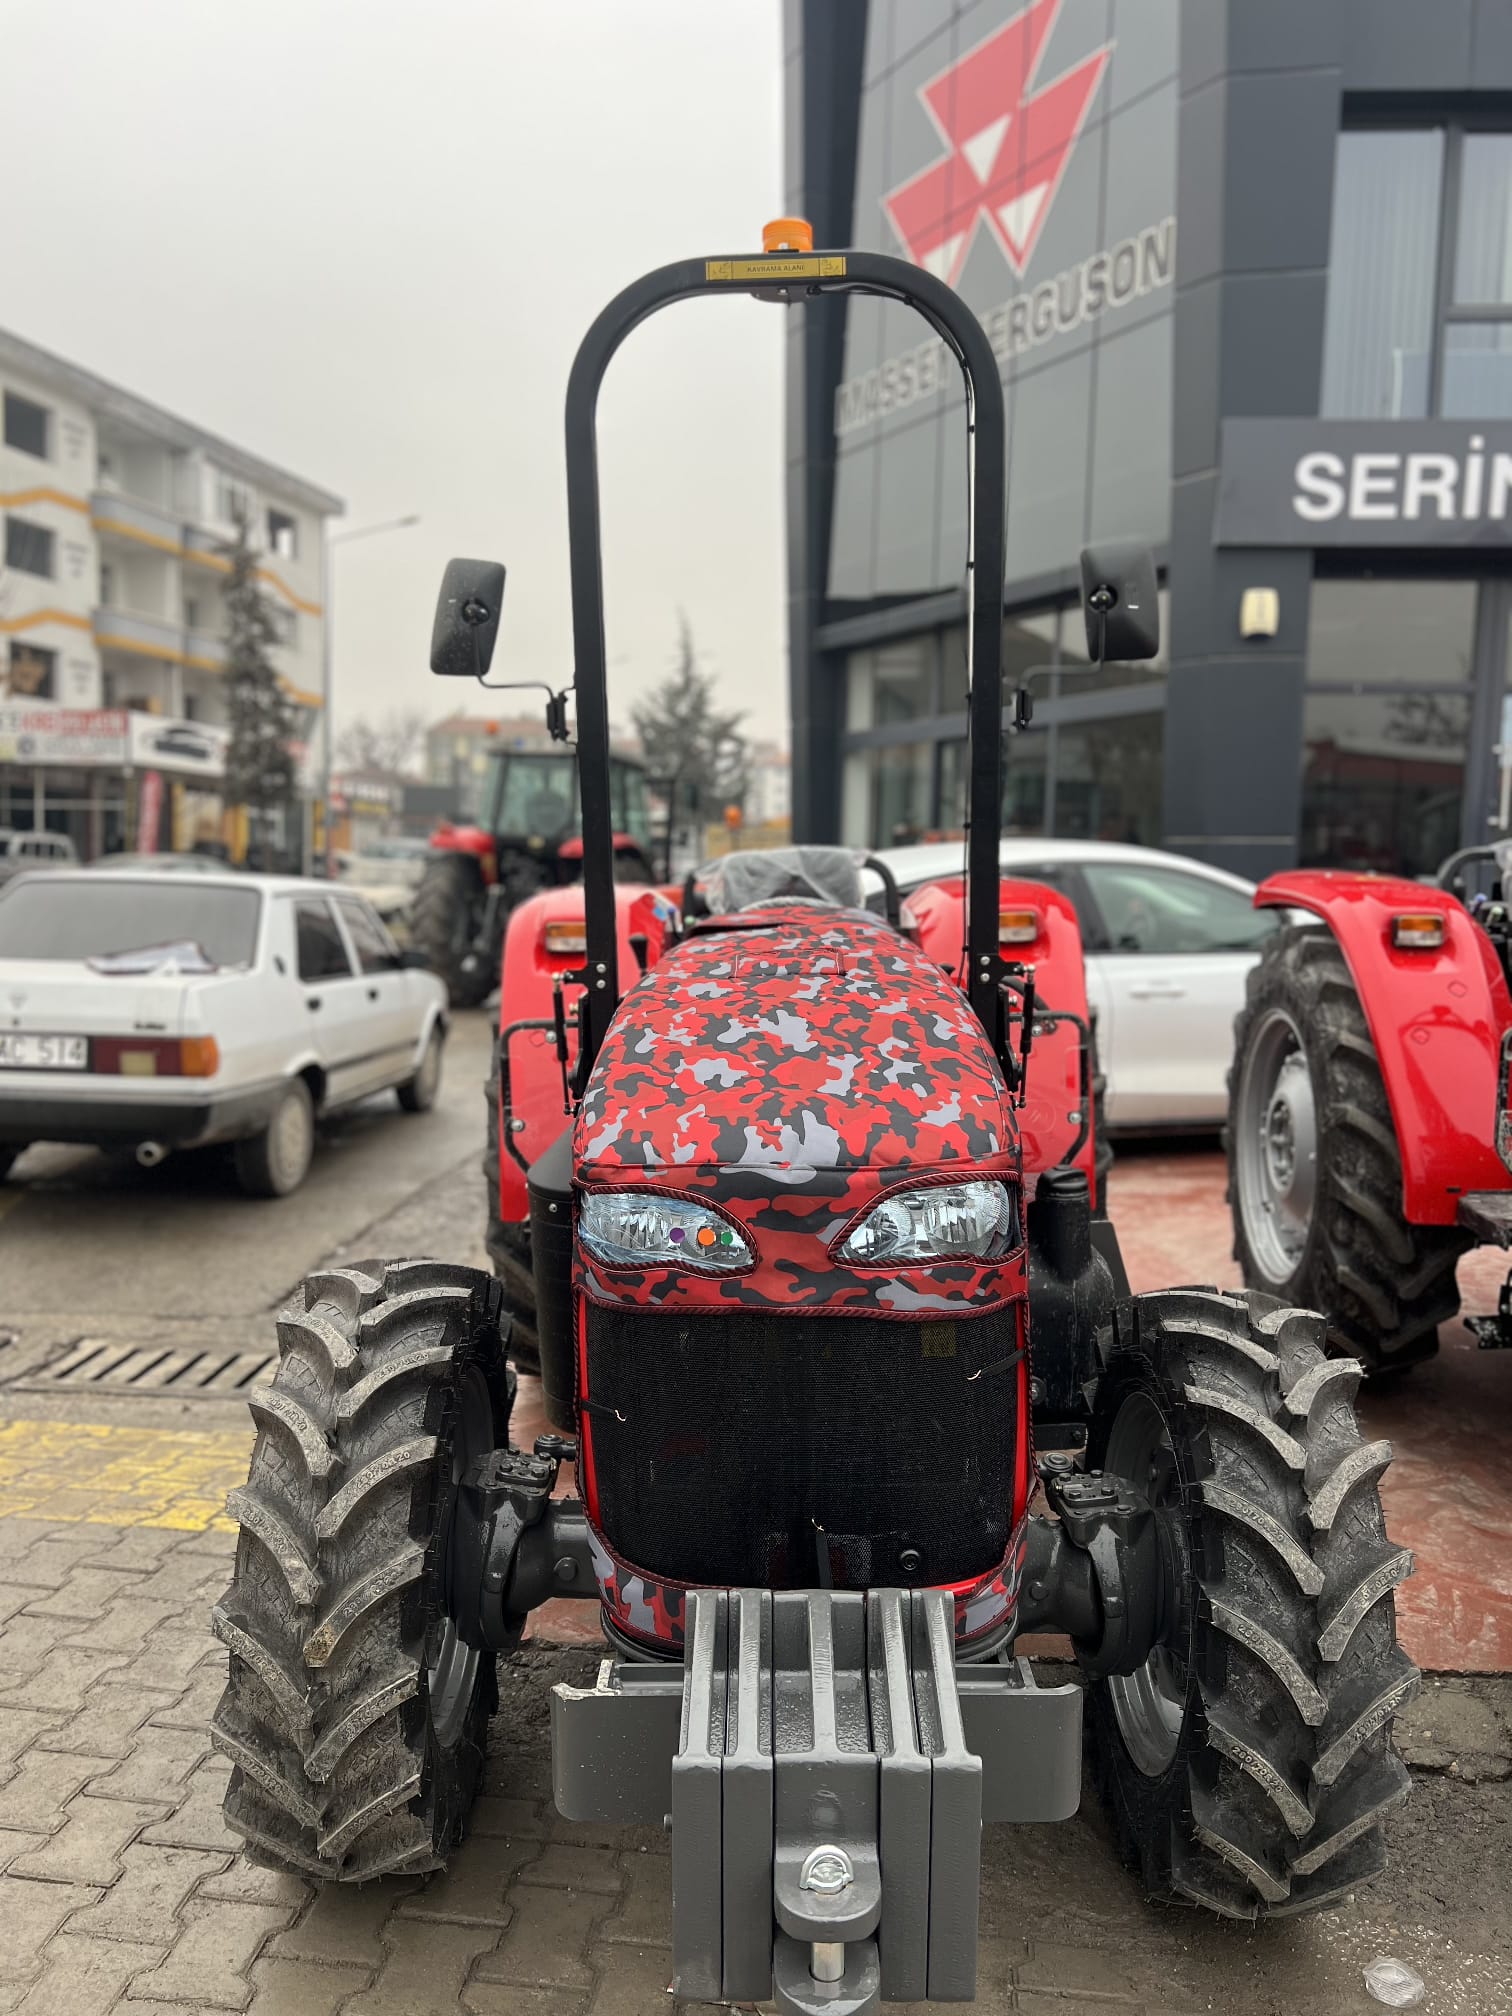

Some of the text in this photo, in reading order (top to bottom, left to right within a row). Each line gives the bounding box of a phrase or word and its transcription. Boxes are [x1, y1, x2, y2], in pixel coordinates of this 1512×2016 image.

[747, 263, 805, 273] KAVRAMA ALANI
[977, 214, 1177, 362] ERGUSON
[38, 1037, 84, 1065] 514
